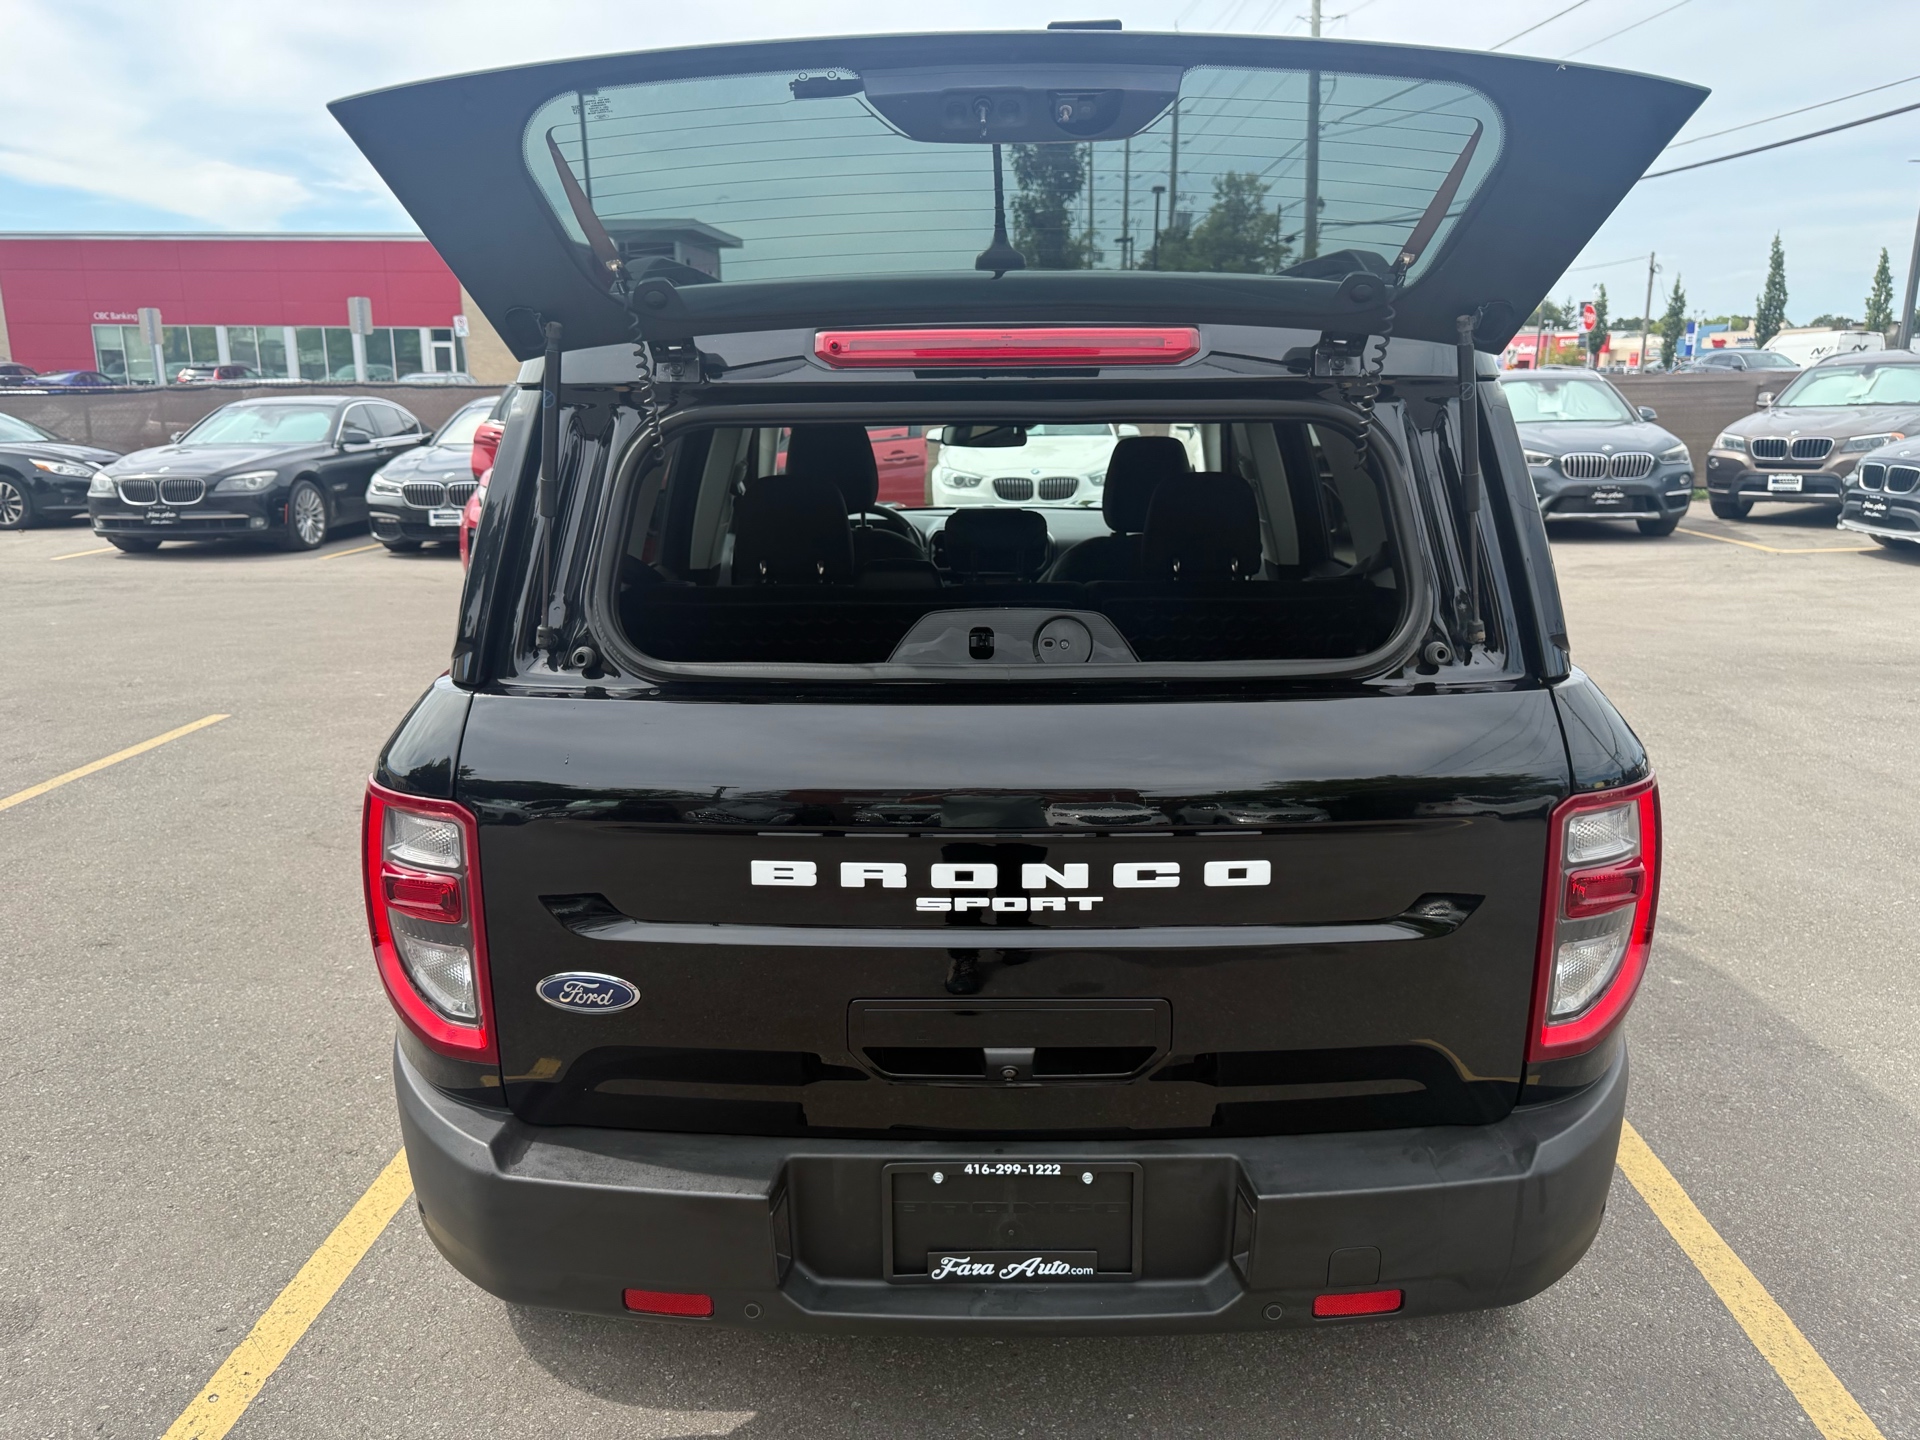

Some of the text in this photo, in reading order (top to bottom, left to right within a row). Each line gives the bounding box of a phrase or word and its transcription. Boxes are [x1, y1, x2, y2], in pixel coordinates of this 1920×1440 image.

[110, 312, 138, 322] Banking
[750, 859, 1272, 889] BRONCO
[915, 896, 1104, 912] SPORT
[558, 980, 614, 1005] Ford
[963, 1163, 1062, 1176] 416-299-1222
[931, 1256, 996, 1280] Fara
